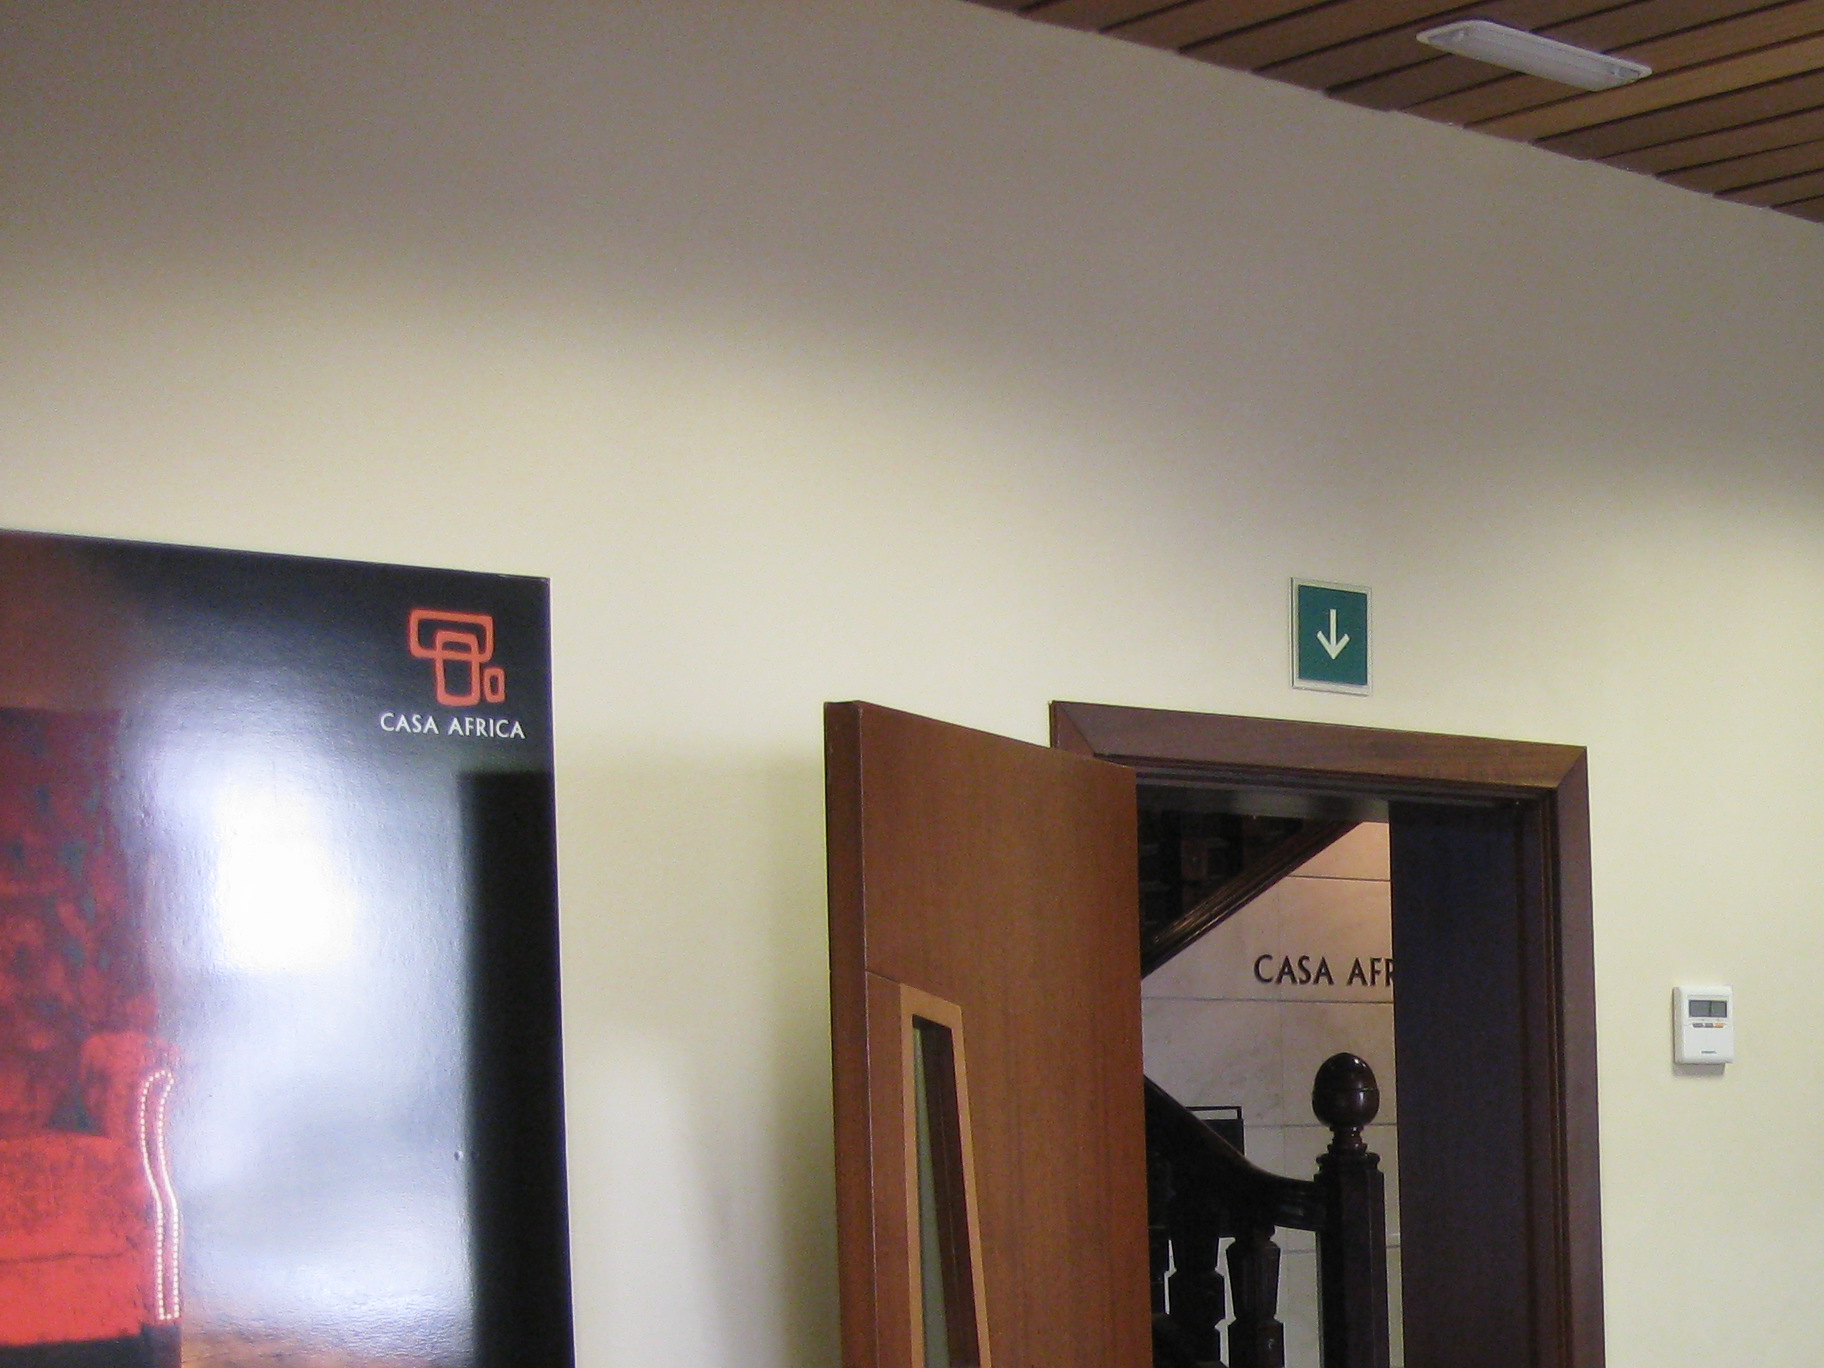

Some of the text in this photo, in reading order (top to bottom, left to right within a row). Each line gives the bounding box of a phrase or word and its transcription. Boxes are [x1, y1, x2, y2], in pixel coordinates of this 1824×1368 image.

[380, 712, 526, 740] CASA AFRICA
[1253, 953, 1335, 986] CASA
